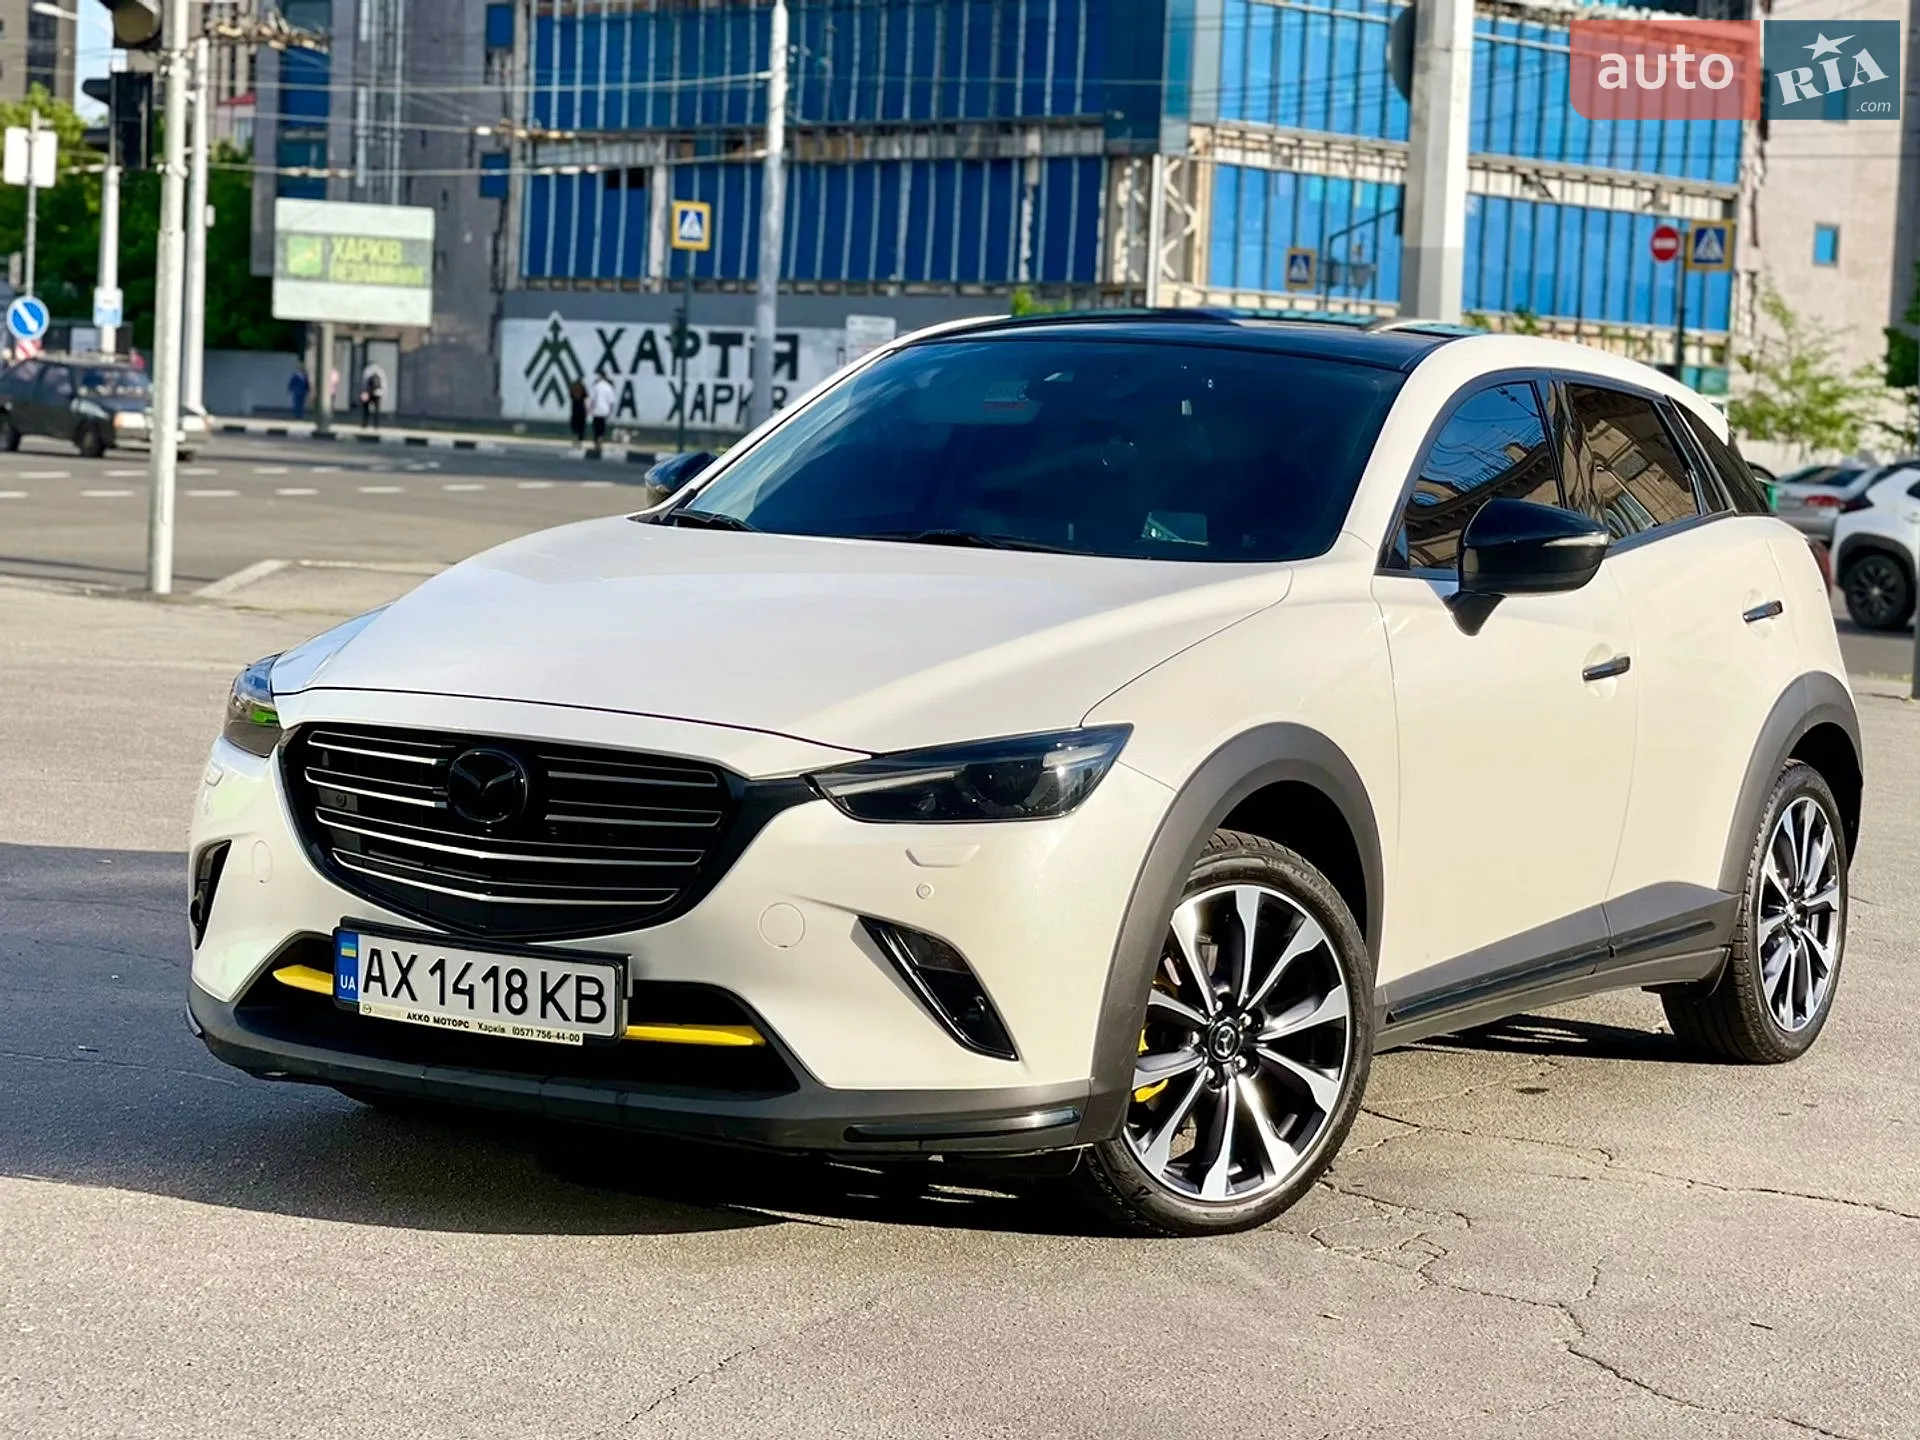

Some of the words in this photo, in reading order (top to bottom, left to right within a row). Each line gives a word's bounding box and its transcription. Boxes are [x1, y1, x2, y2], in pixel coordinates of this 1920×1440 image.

[666, 380, 789, 424] ХАРКВ
[339, 974, 356, 990] UA
[362, 948, 419, 1002] AX
[428, 958, 528, 1016] 1418
[540, 970, 607, 1024] KB
[433, 1015, 470, 1030] МОТОРС
[512, 1026, 534, 1037] (057)
